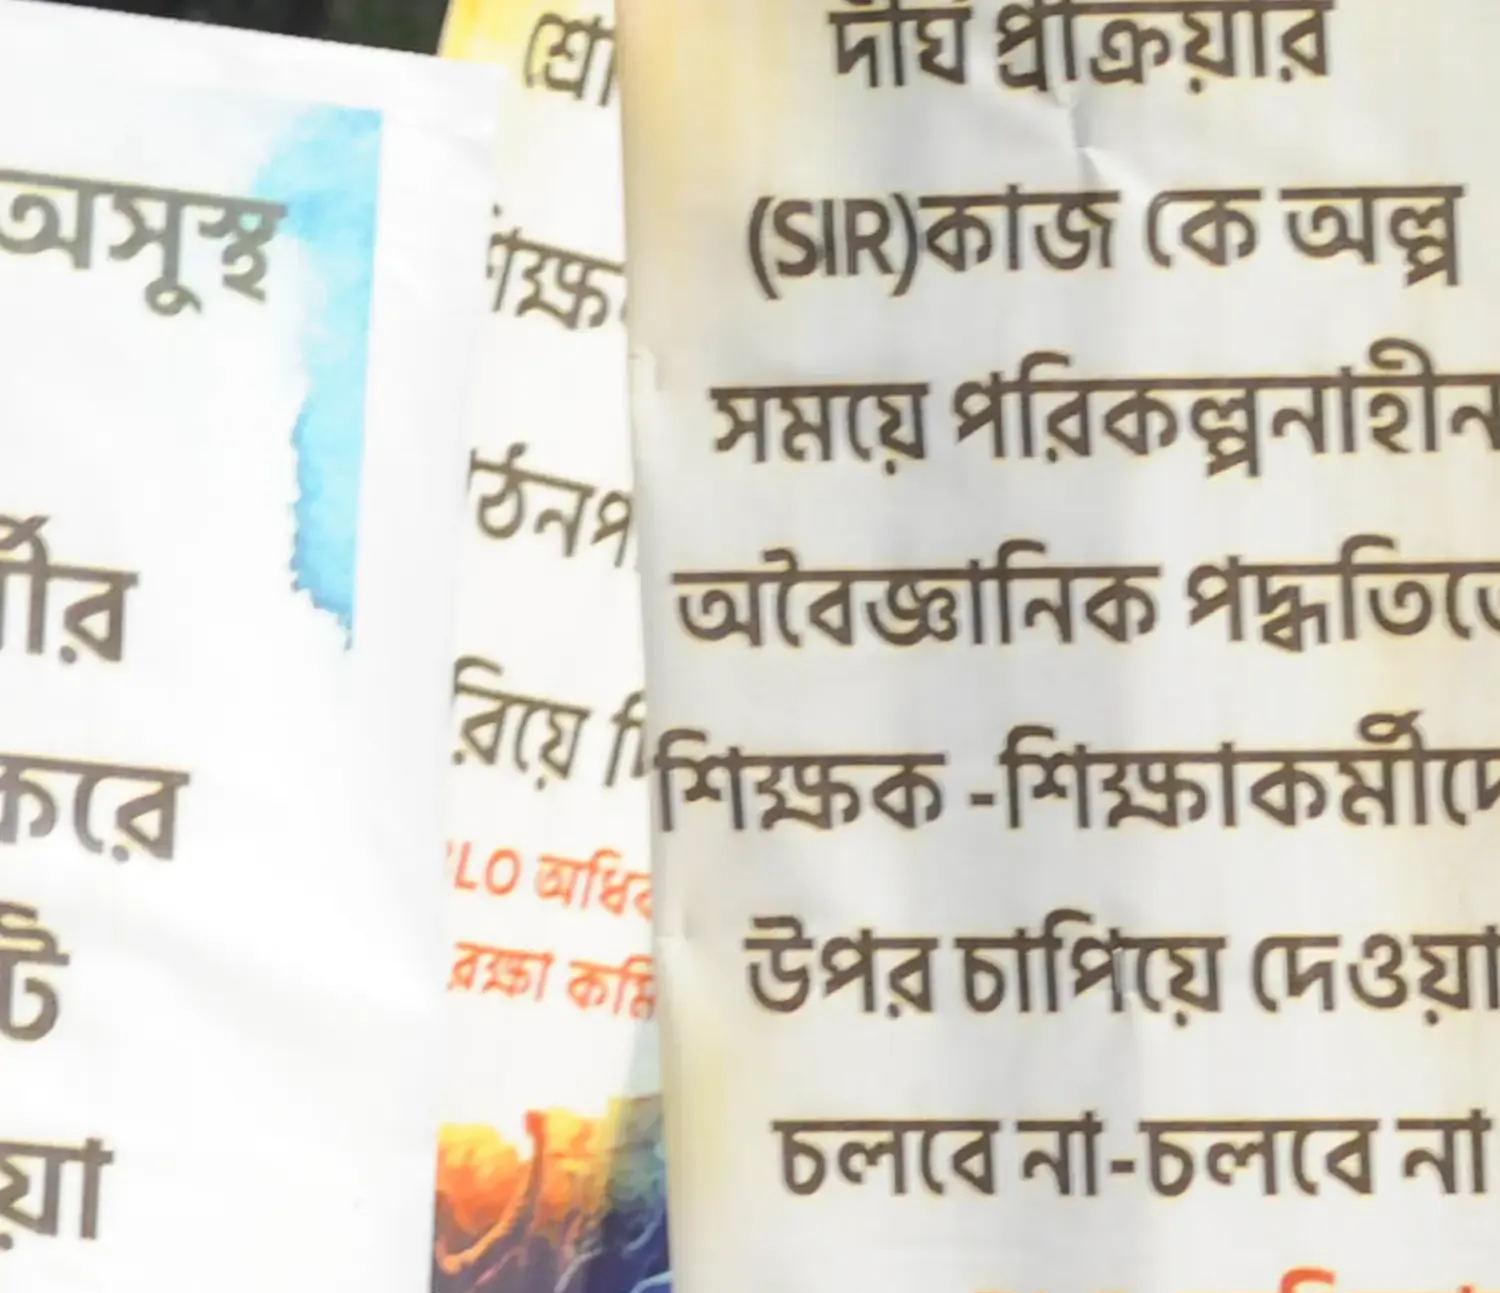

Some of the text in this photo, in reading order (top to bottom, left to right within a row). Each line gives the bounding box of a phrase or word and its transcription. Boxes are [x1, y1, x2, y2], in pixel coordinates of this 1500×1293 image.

[748, 184, 1464, 300] (SIR)কাজ কে অল্প
[709, 383, 929, 475] সময়ে
[672, 539, 1161, 647] অবৈজ্ঞানিক
[652, 729, 946, 832] শিক্ষক
[448, 842, 520, 896] LO
[744, 916, 939, 1018] উপর
[954, 909, 1227, 1027] চাপিয়ে
[772, 1120, 1000, 1195] চলবে
